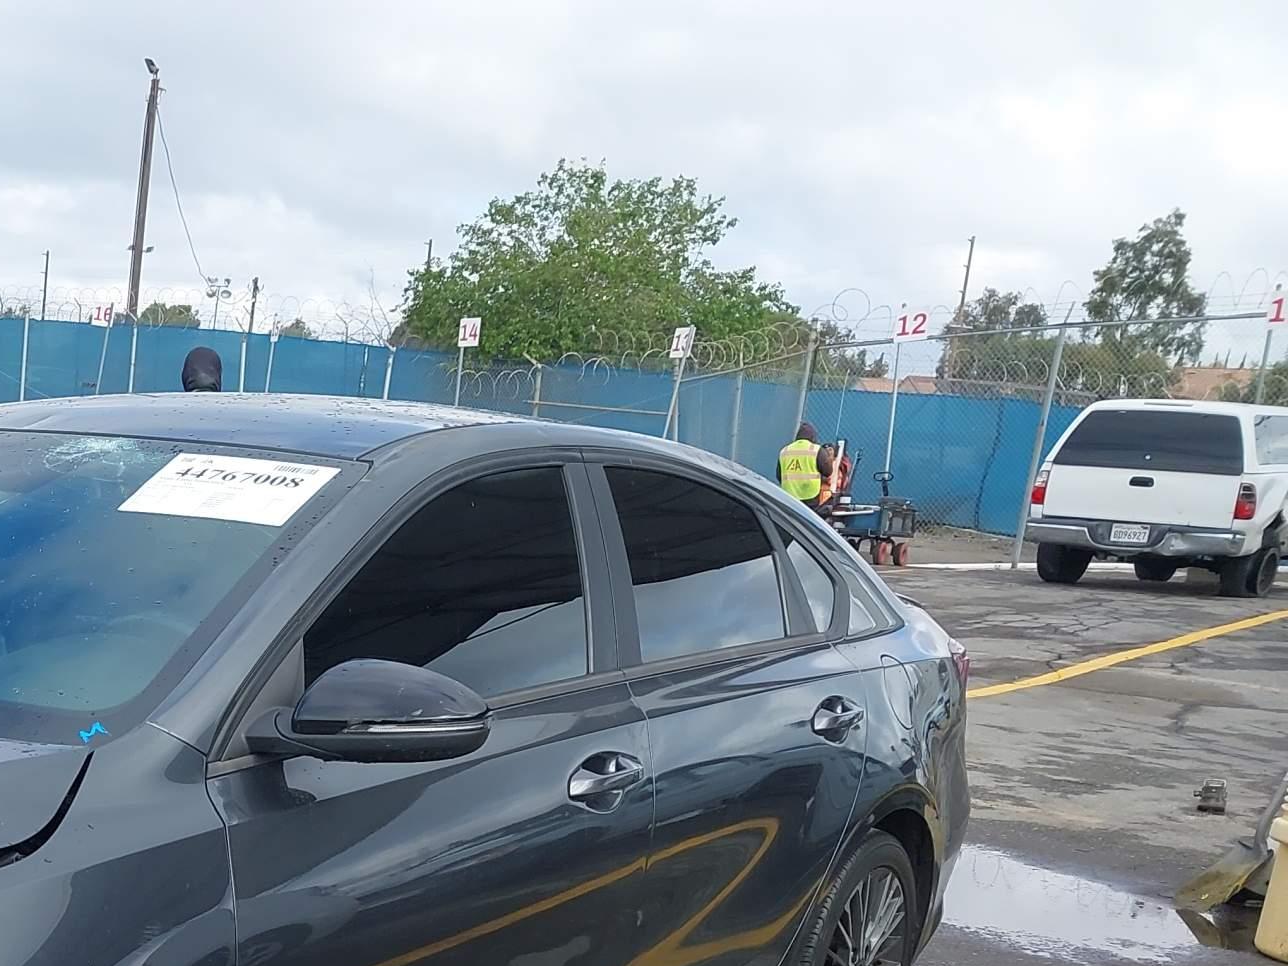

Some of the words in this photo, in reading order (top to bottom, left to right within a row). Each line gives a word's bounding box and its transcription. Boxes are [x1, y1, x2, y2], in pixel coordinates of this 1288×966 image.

[93, 306, 112, 321] 16
[460, 323, 478, 341] 14
[896, 312, 927, 336] 12
[175, 466, 305, 489] 44767008
